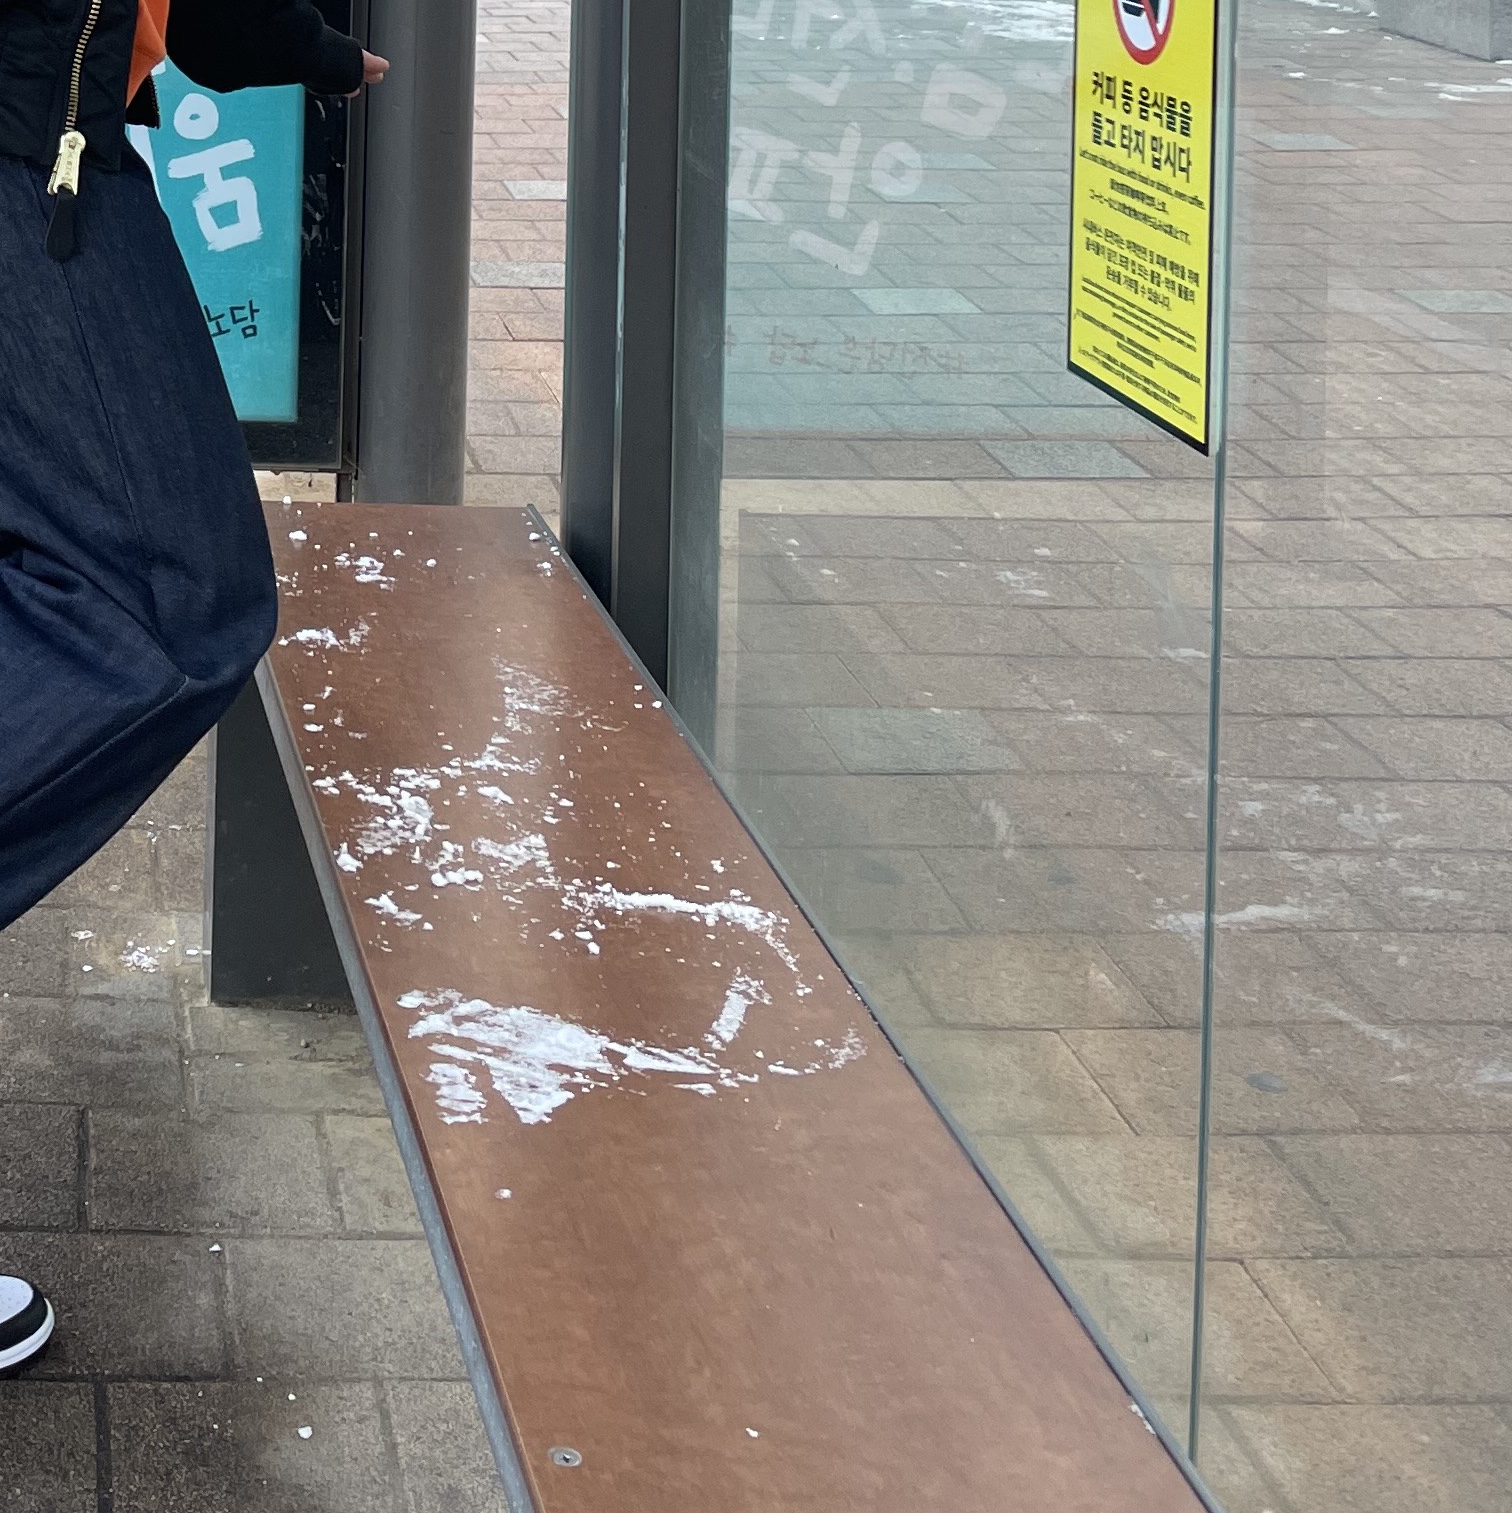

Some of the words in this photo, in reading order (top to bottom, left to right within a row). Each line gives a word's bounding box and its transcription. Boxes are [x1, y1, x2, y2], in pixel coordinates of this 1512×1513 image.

[1092, 71, 1117, 109] 커피
[1121, 79, 1134, 115] 등
[1138, 86, 1193, 138] 음식물을
[1092, 110, 1117, 148] 들고
[1120, 124, 1145, 164] 타지
[1151, 135, 1193, 184] 맙시다
